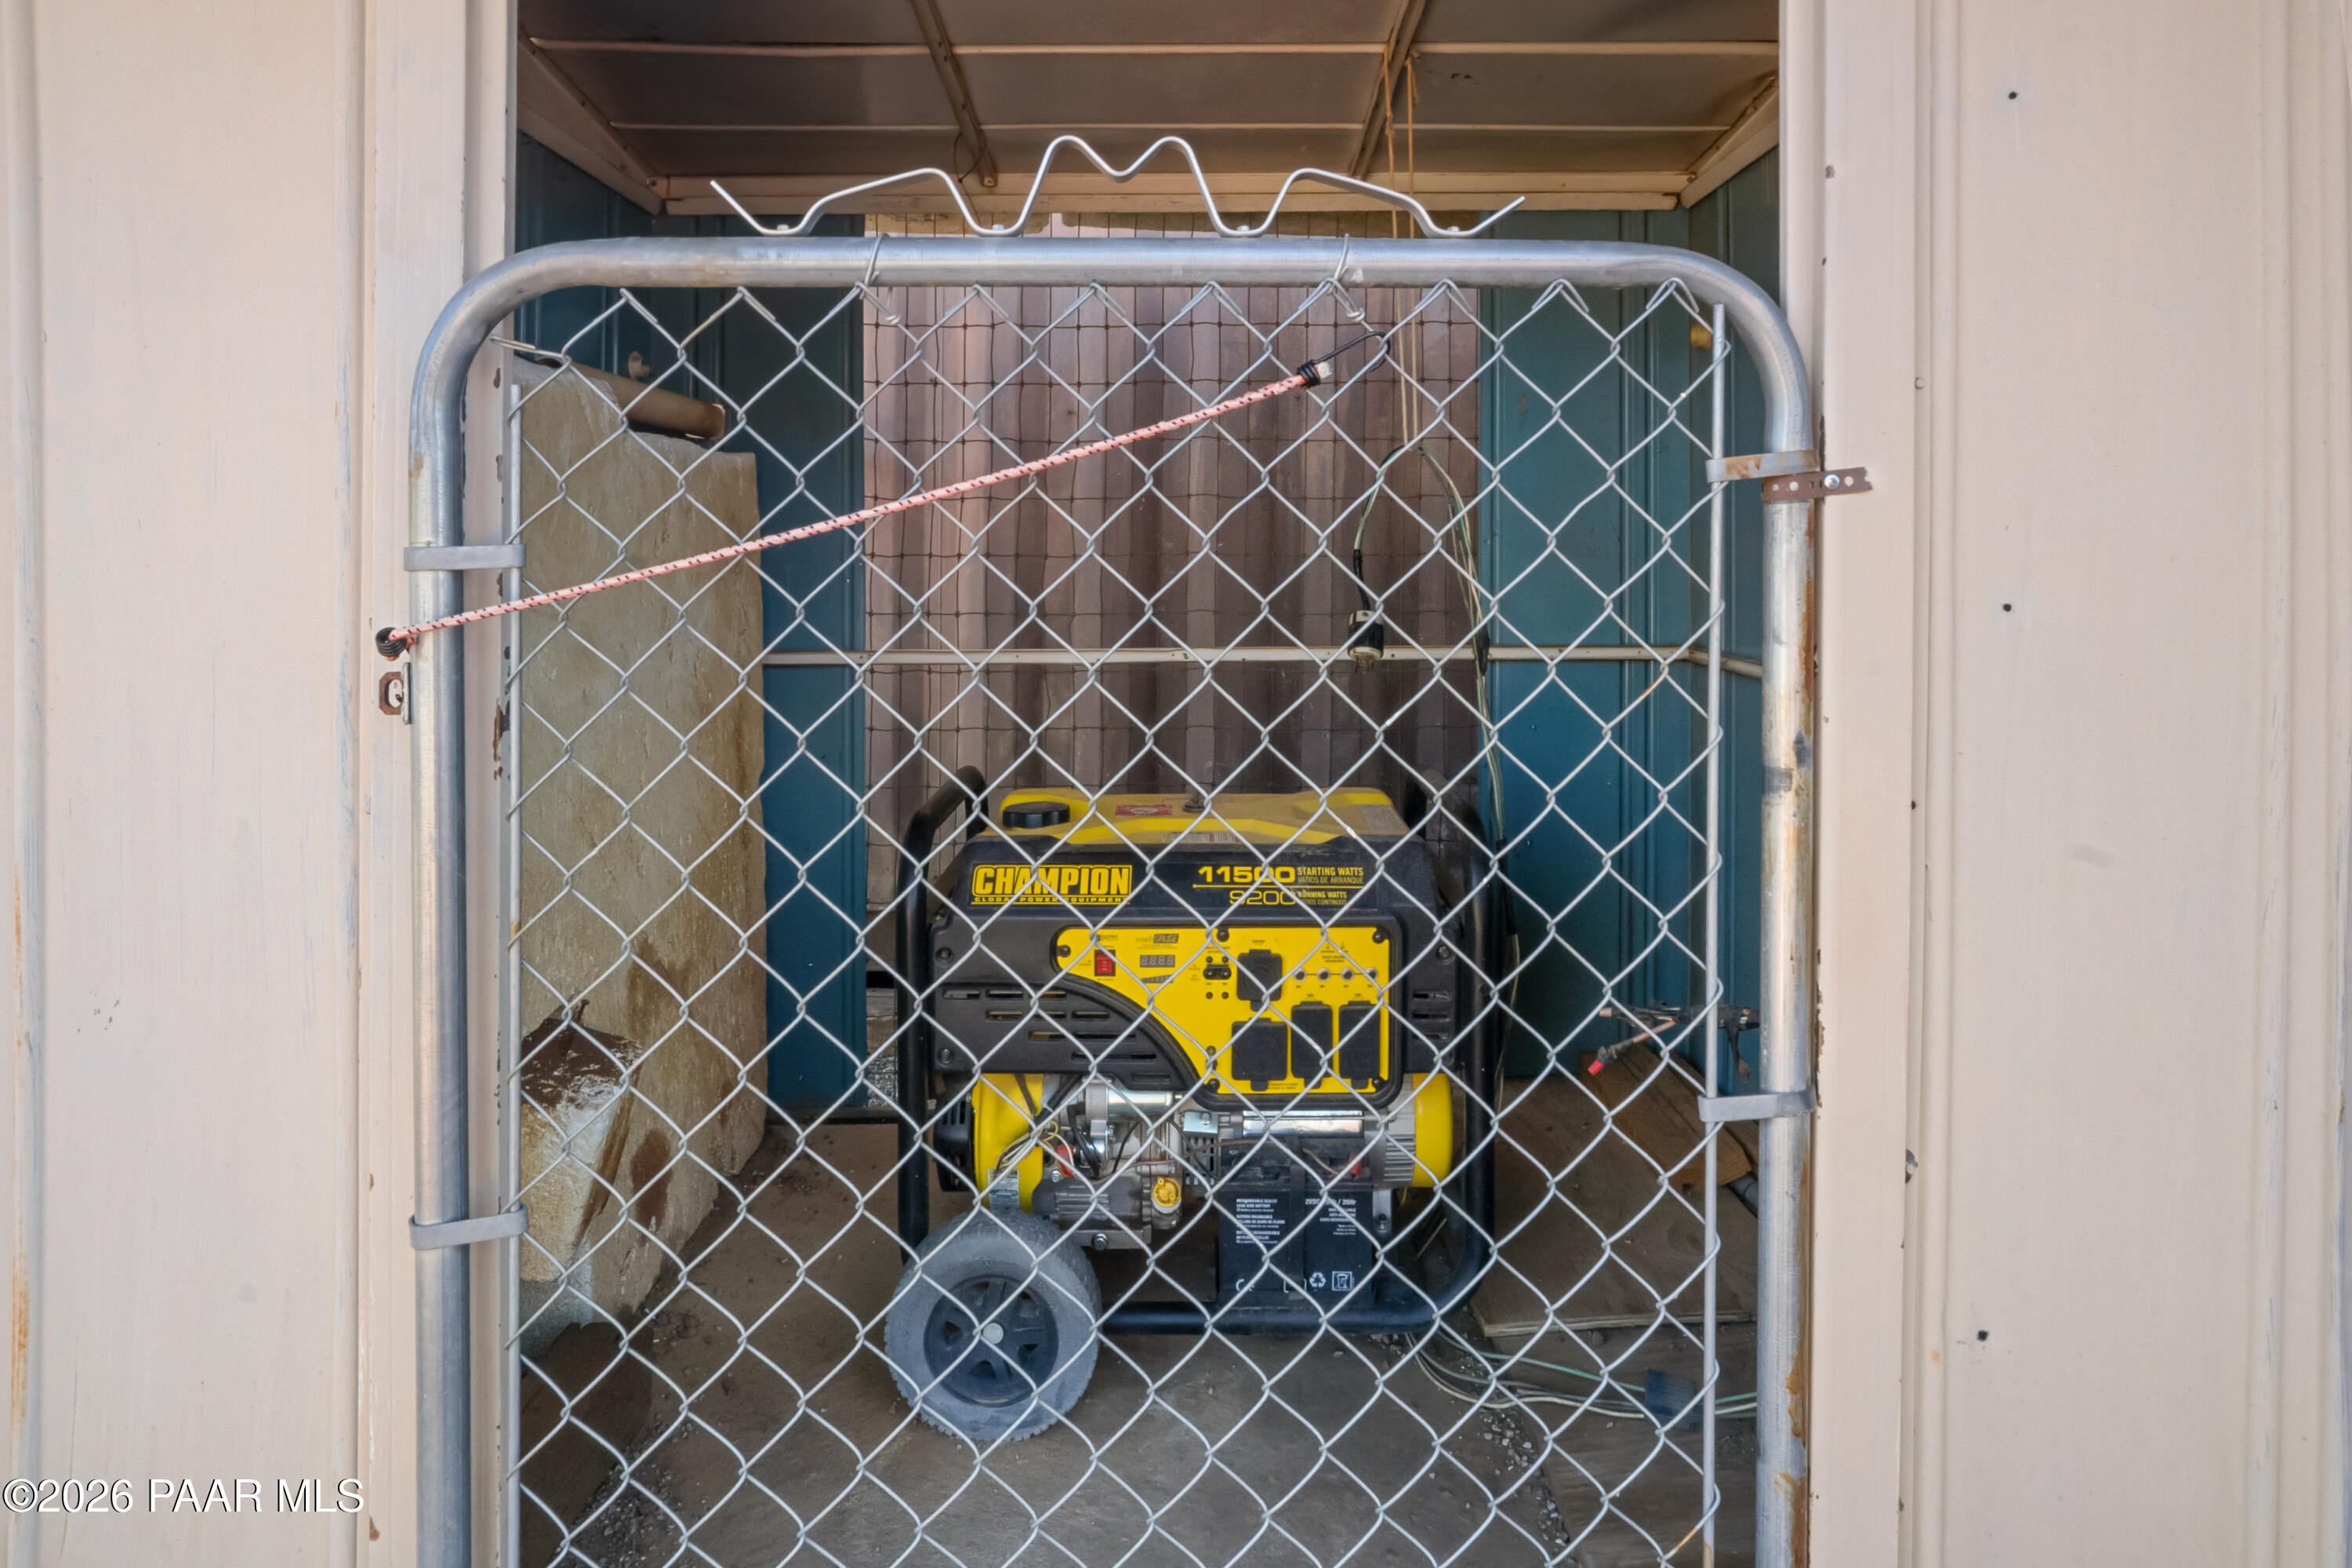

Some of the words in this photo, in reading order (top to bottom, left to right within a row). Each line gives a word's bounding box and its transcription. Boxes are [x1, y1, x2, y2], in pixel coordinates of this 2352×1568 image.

[1198, 866, 1296, 883] 11500
[1298, 866, 1336, 877] STARTING
[1338, 866, 1364, 877] WATTS
[975, 866, 1130, 895] CHAMPION
[1229, 891, 1297, 905] 9200
